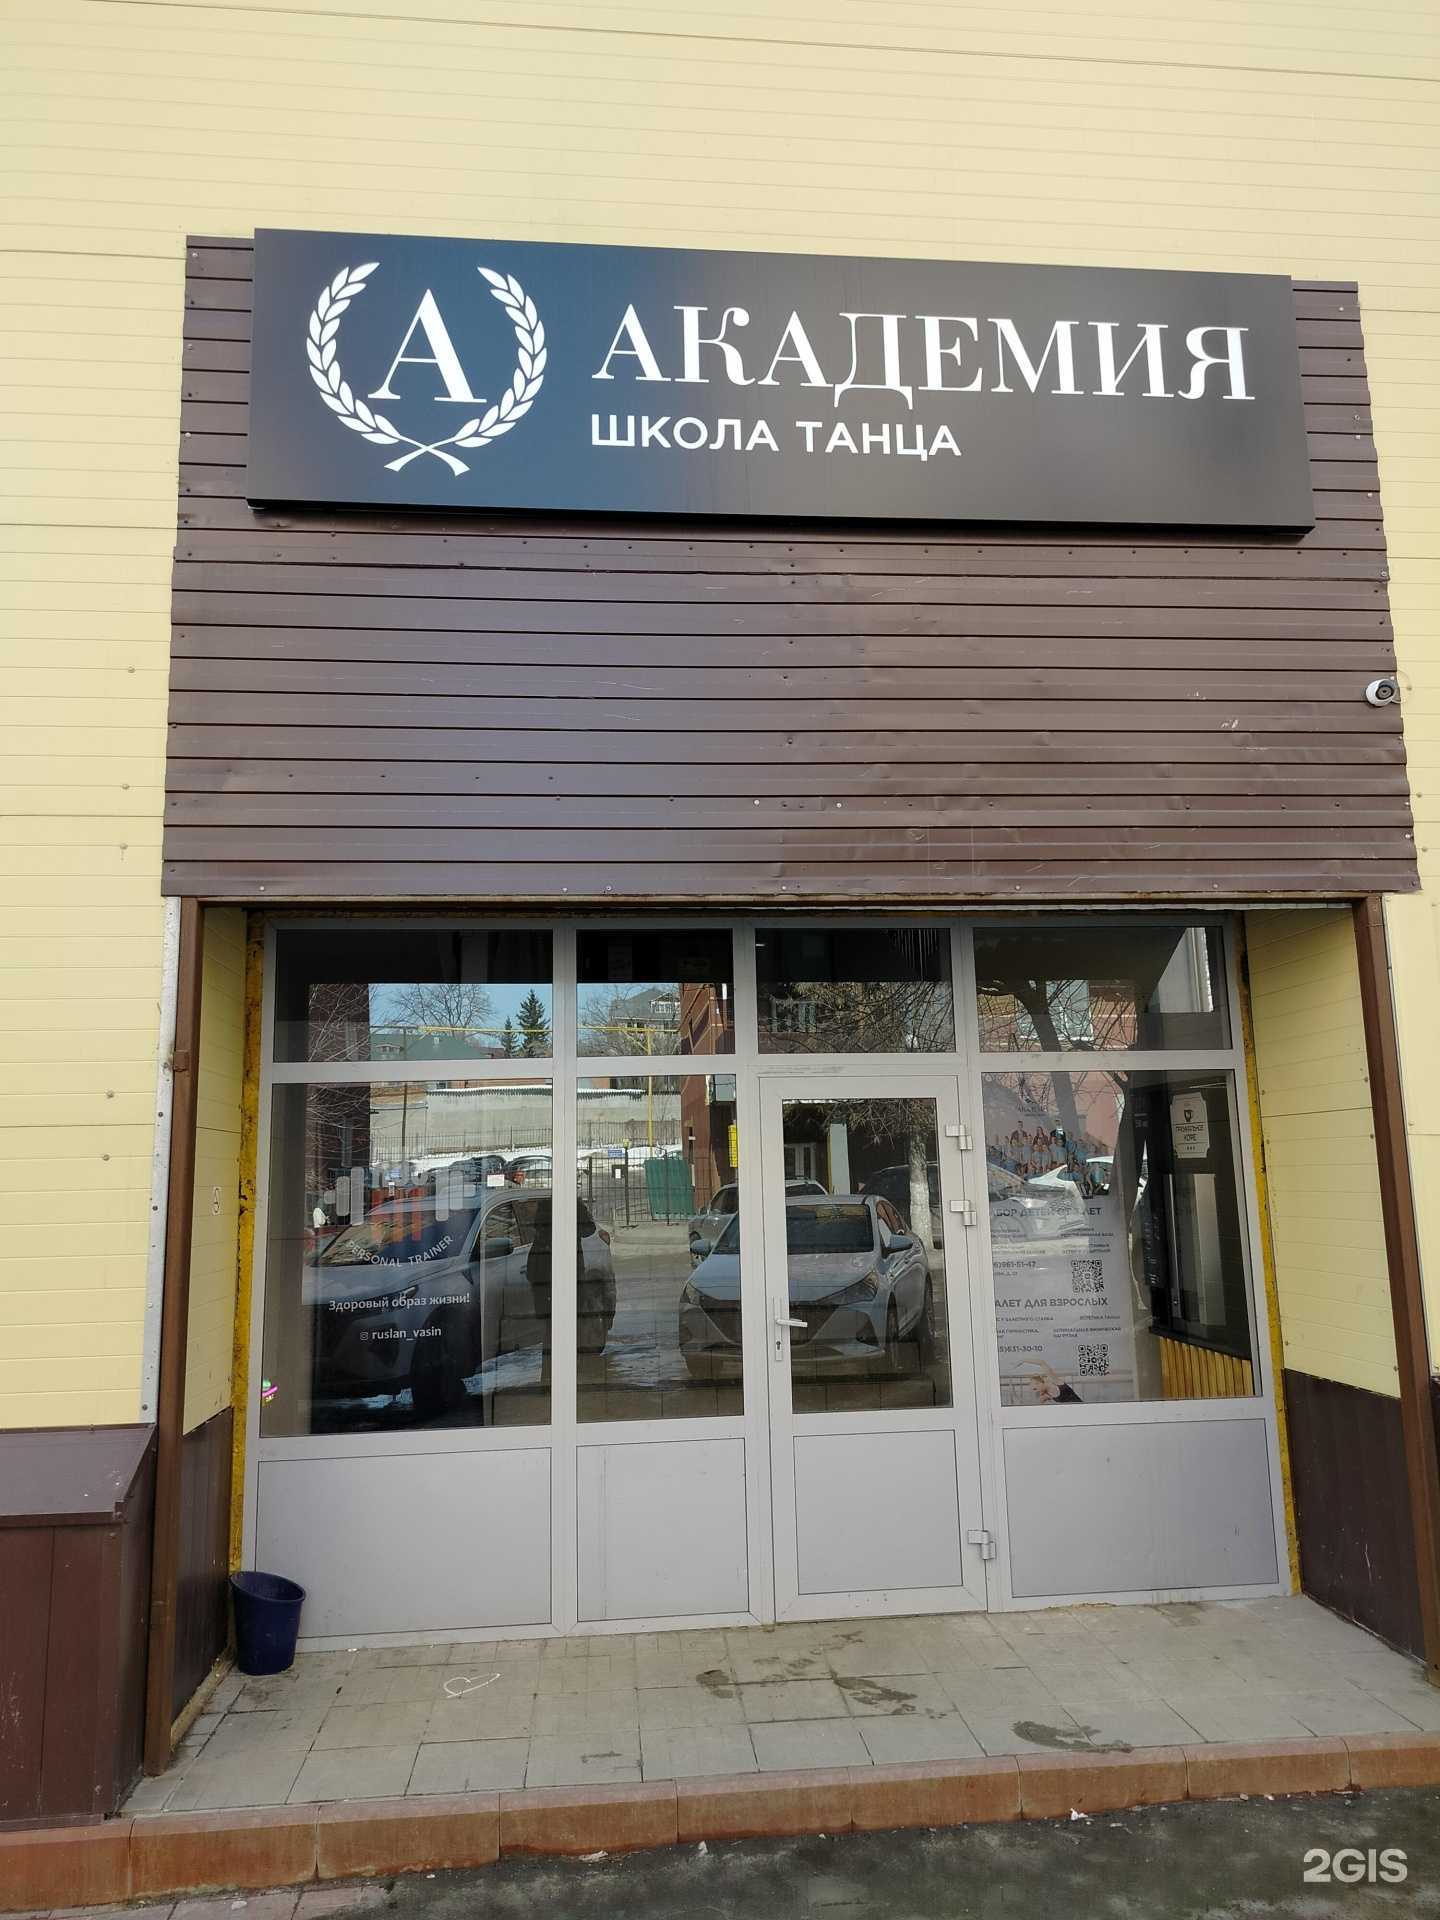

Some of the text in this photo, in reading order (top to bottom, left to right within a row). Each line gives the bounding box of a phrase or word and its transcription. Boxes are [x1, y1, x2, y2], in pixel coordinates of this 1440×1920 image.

[590, 303, 1256, 411] АКАДЕМИЯ
[590, 411, 963, 461] ШКОЛА ТАНЦА
[345, 1234, 455, 1268] PERSONAL TRAINER
[328, 1292, 471, 1313] Здоровый образ жизни!
[1024, 1298, 1048, 1309] ДЛЯ
[1049, 1297, 1109, 1307] ВЗРОСЛЫХ
[371, 1326, 443, 1342] ruslan_vasin
